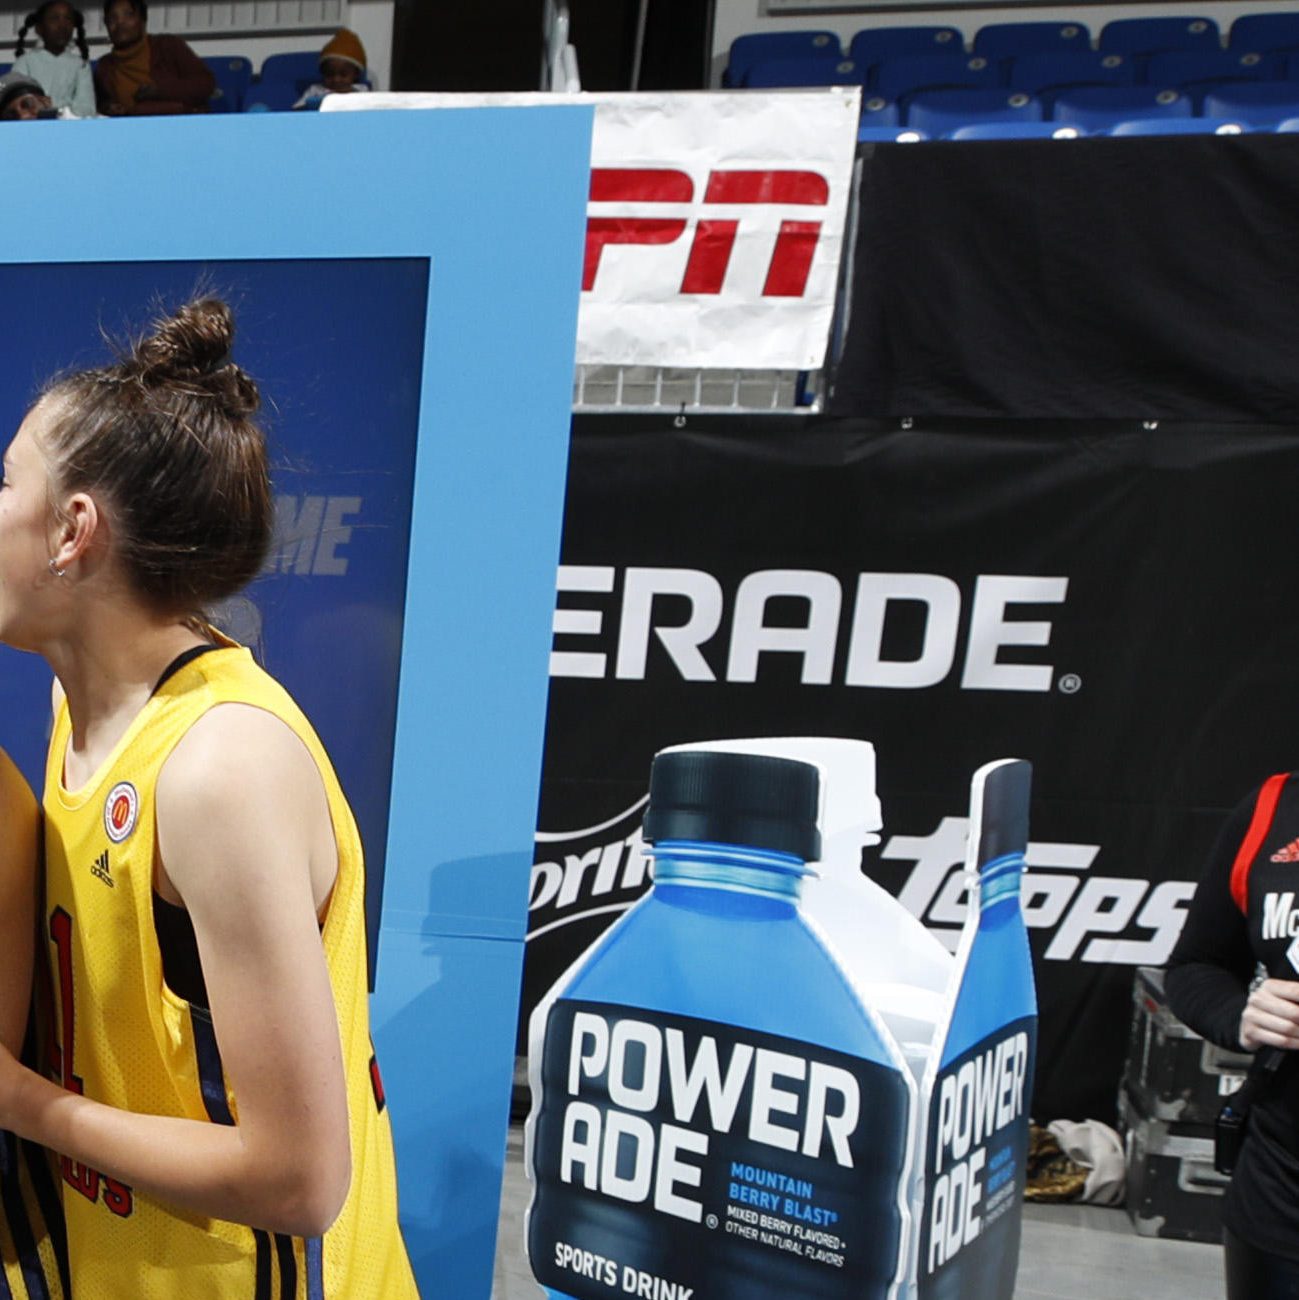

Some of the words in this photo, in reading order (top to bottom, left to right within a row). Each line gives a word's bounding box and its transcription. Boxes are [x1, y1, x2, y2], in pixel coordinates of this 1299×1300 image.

[568, 1011, 861, 1169] POWER
[936, 1031, 1028, 1175] POWER
[728, 1182, 780, 1212] BERRY
[730, 1162, 813, 1199] MOUNTAIN
[727, 1205, 760, 1225] MIXED
[759, 1214, 793, 1235] BERRY
[793, 1224, 840, 1250] FLAVORED
[928, 1147, 986, 1274] ADE
[555, 1241, 618, 1287] SPORTS
[725, 1221, 760, 1240] OTHER
[759, 1231, 803, 1256] NATURAL
[804, 1245, 845, 1268] FLAVORS
